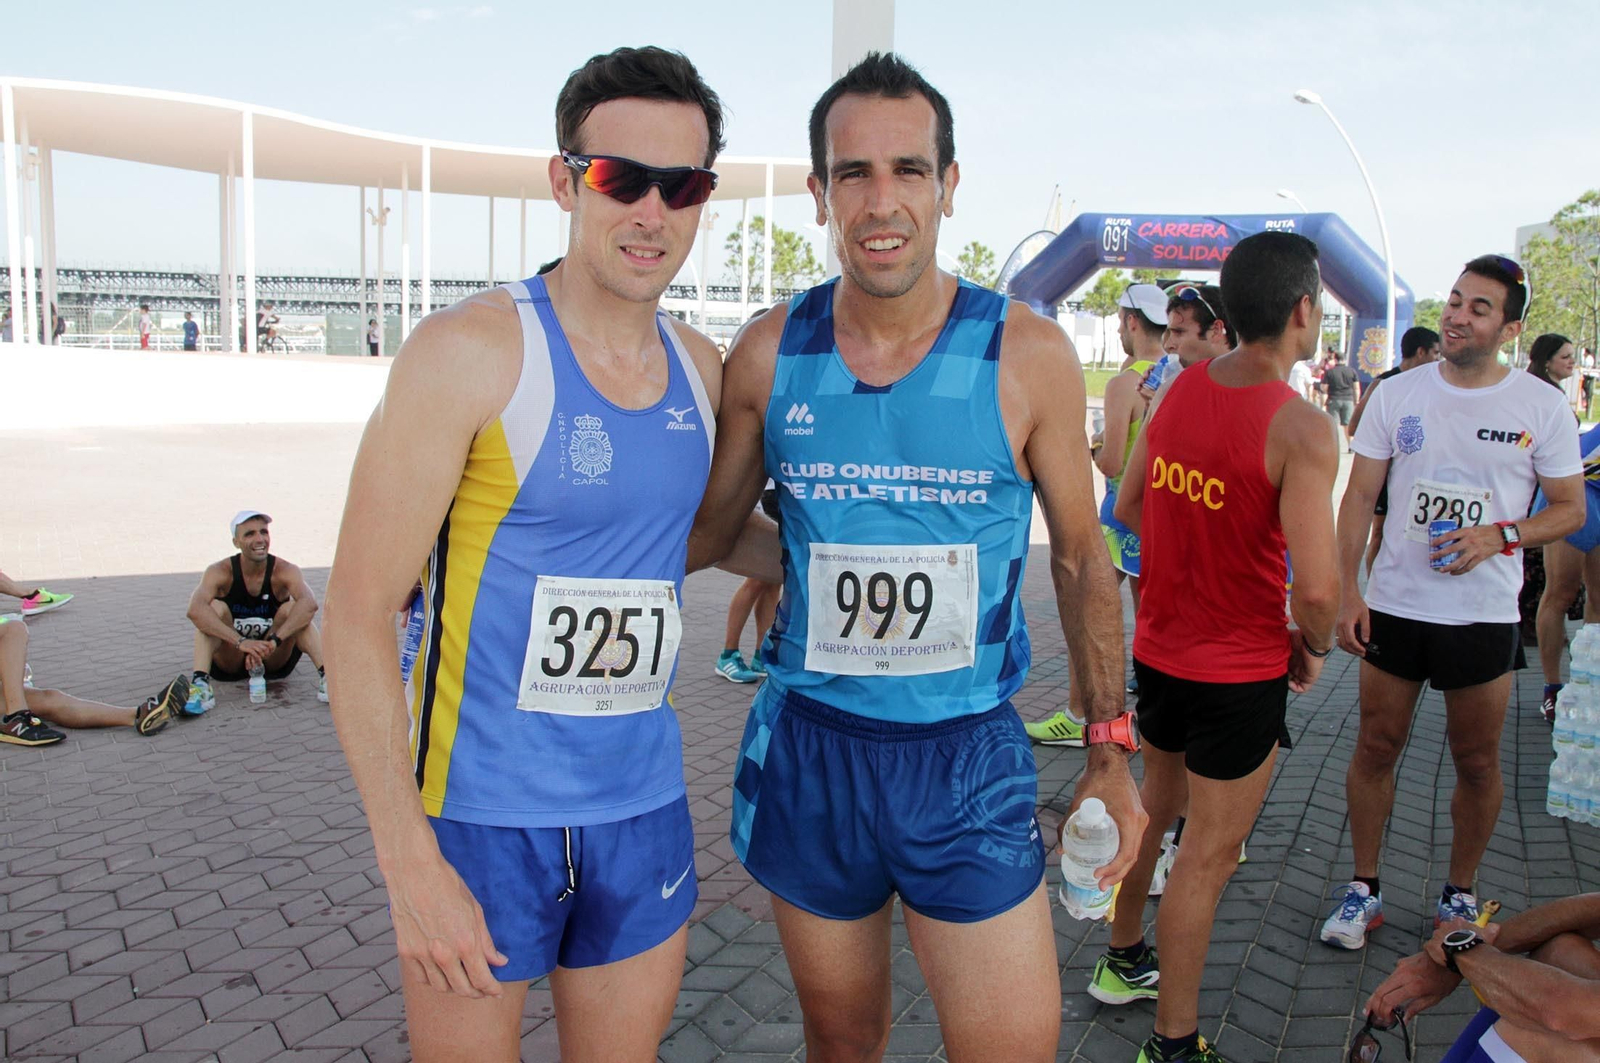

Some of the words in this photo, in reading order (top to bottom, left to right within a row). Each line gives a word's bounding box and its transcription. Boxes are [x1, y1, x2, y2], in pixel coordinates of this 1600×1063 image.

[1105, 217, 1132, 226] RUTA
[1265, 219, 1295, 229] RUTA
[1138, 222, 1229, 239] CARRERA
[1103, 226, 1128, 252] 091
[784, 427, 814, 436] mobel
[1477, 428, 1520, 443] CNP
[780, 462, 835, 478] CLUB
[839, 463, 994, 485] ONUBENSE
[572, 478, 609, 486] CAPOL
[811, 483, 988, 505] ATLETISMO
[1413, 492, 1483, 529] 3289
[850, 554, 888, 564] GENERAL
[889, 556, 900, 564] DE
[902, 556, 913, 564] LA
[587, 588, 620, 598] GENERAL
[622, 589, 632, 598] DE
[633, 589, 642, 598] LA
[836, 570, 934, 640] 999
[540, 605, 665, 678] 3251
[814, 640, 888, 656] AGRUPACIÓN
[891, 641, 958, 656] DEPORTIVA
[875, 660, 890, 670] 999
[529, 681, 610, 695] AGRUPACIÓN
[614, 680, 666, 694] DEPORTIVA
[595, 700, 613, 711] 3251
